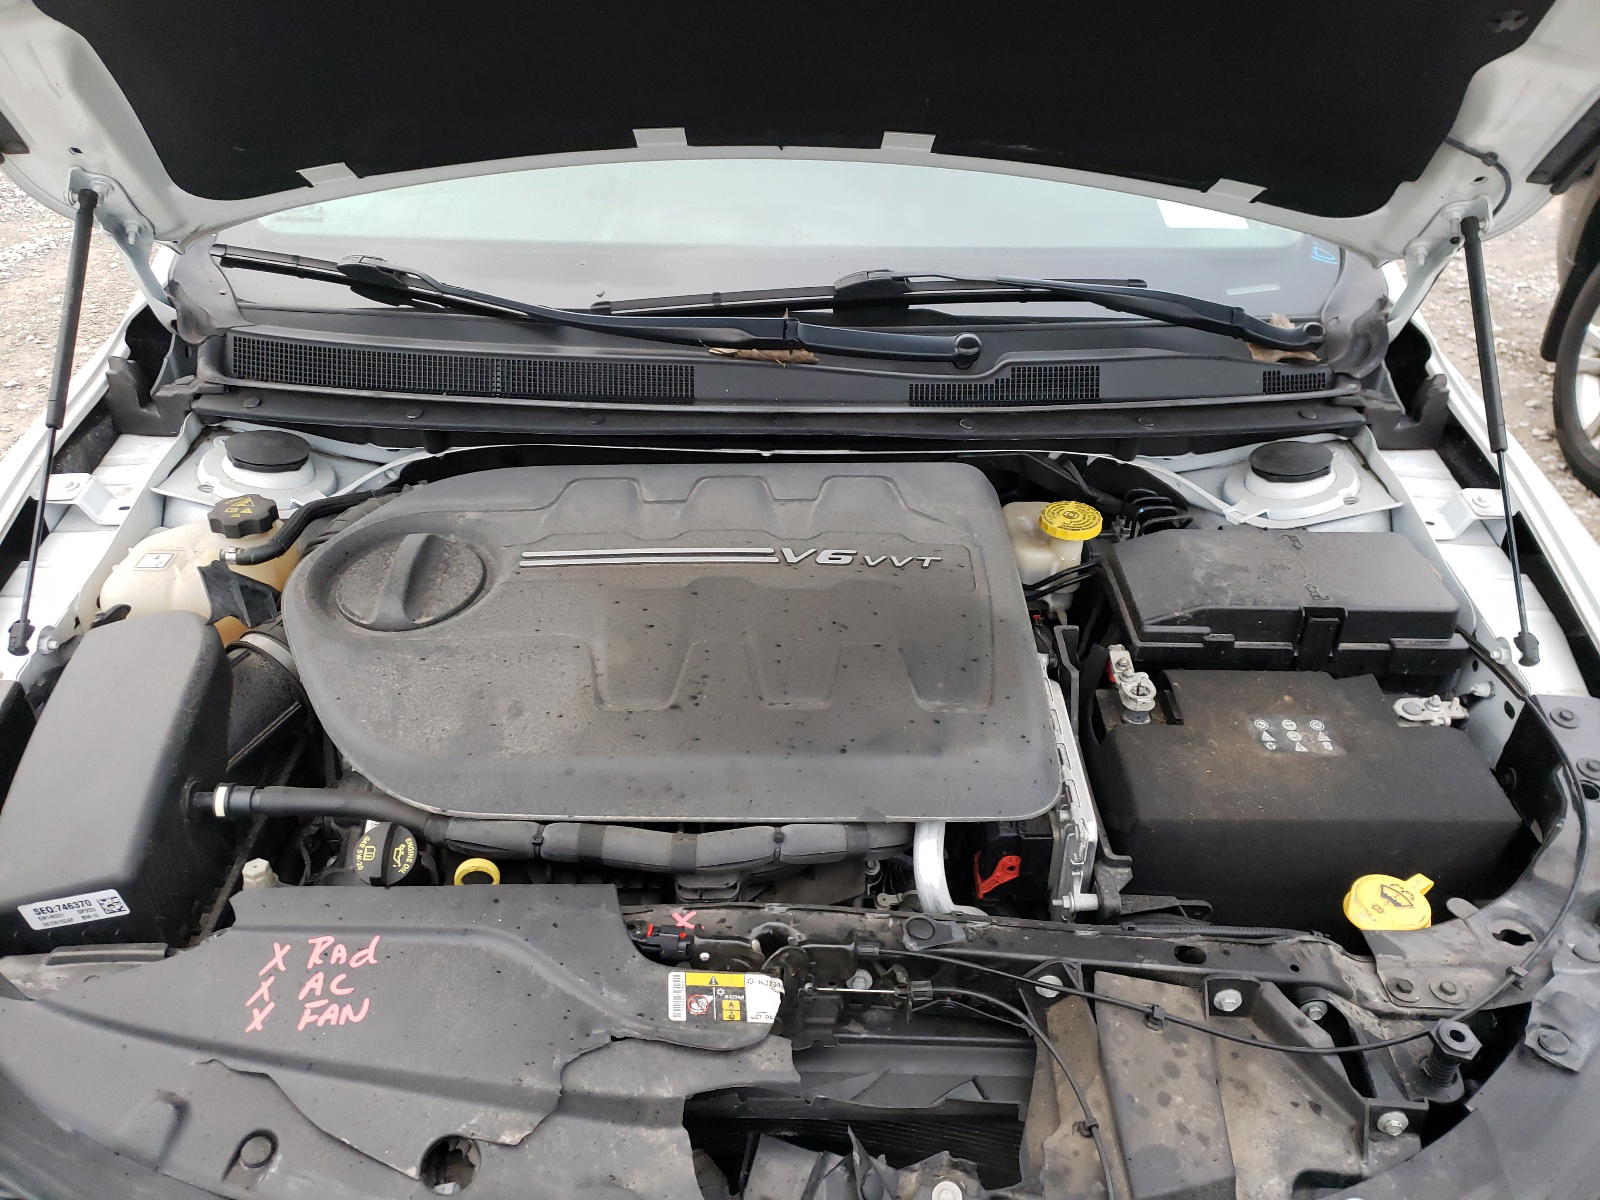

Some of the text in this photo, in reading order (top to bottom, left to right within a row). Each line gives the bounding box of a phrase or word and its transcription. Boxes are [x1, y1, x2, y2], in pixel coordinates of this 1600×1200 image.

[781, 547, 943, 568] V6 VVT
[398, 837, 416, 874] ENGINE OIL
[33, 900, 93, 916] SEQ:746370
[298, 971, 355, 1001] AC
[297, 997, 370, 1032] FAN
